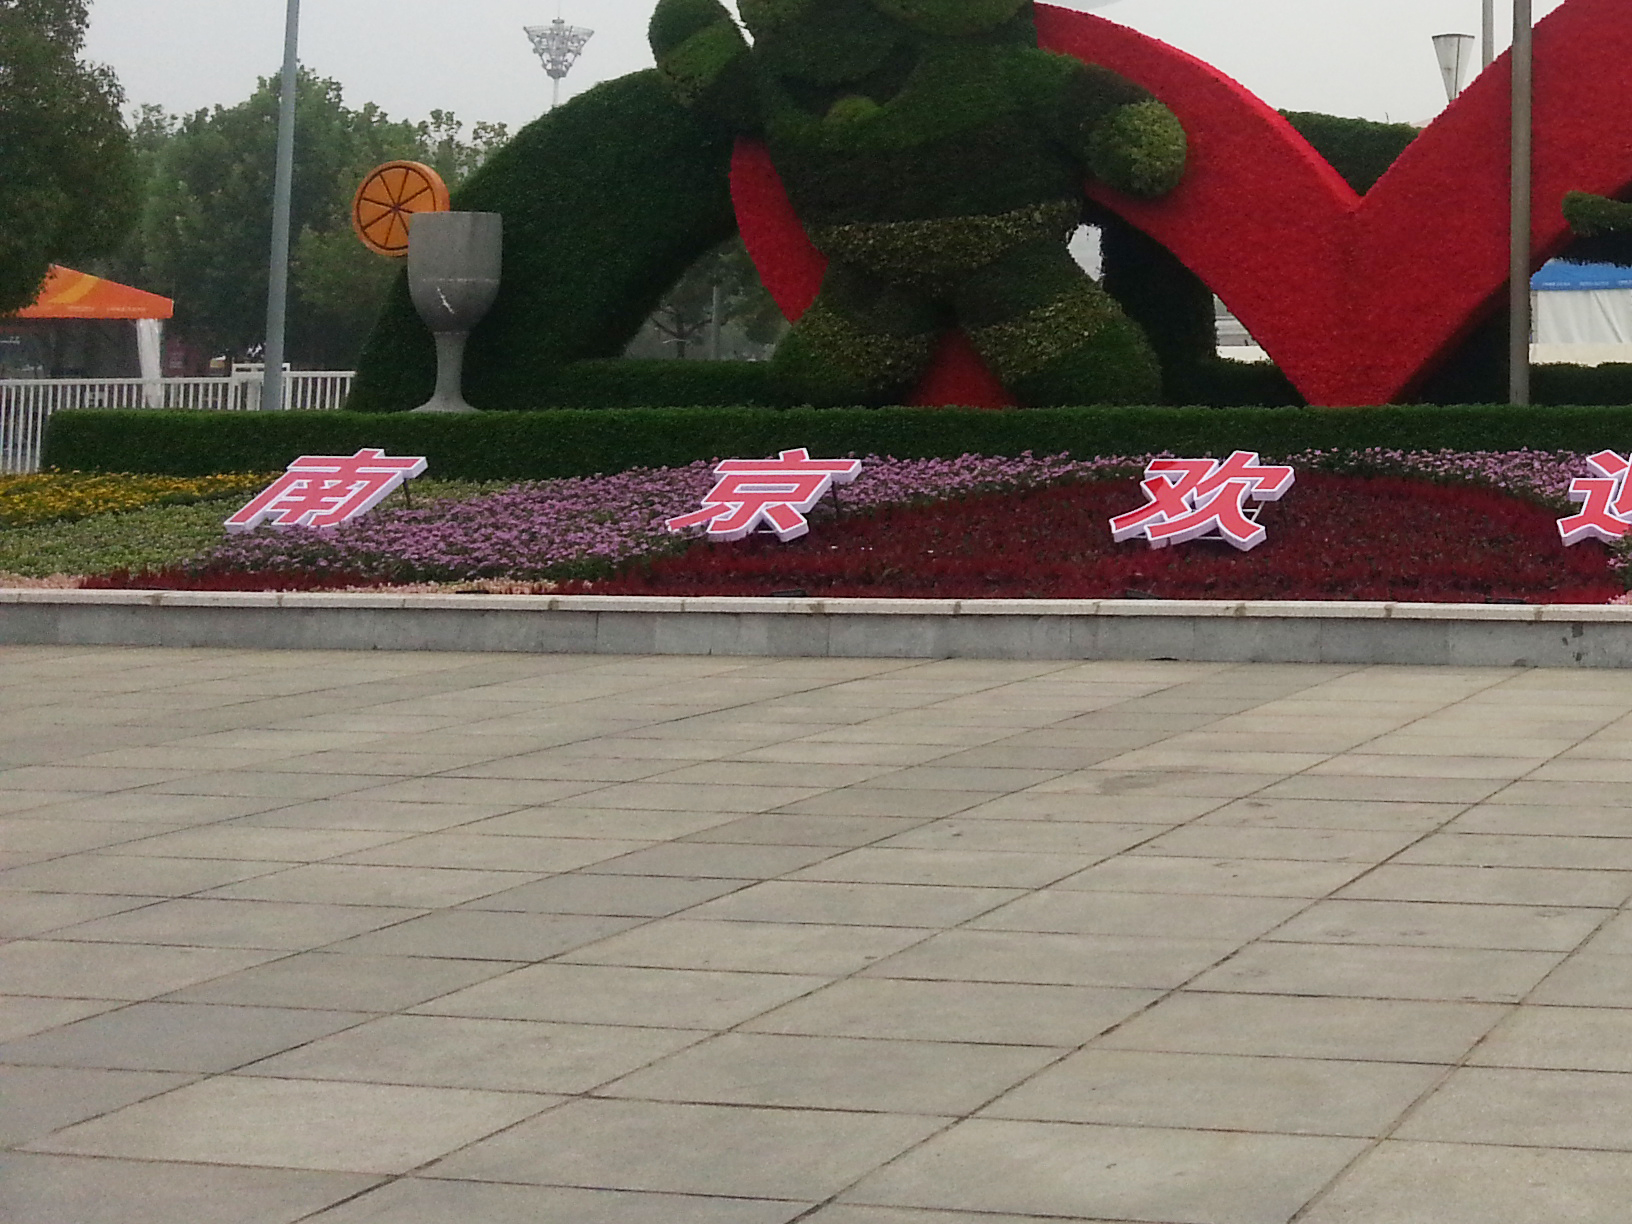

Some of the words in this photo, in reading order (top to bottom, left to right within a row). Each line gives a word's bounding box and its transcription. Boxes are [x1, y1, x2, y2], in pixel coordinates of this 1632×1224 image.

[223, 448, 428, 532] 南
[666, 448, 862, 542] 京
[1108, 449, 1294, 552] 欢
